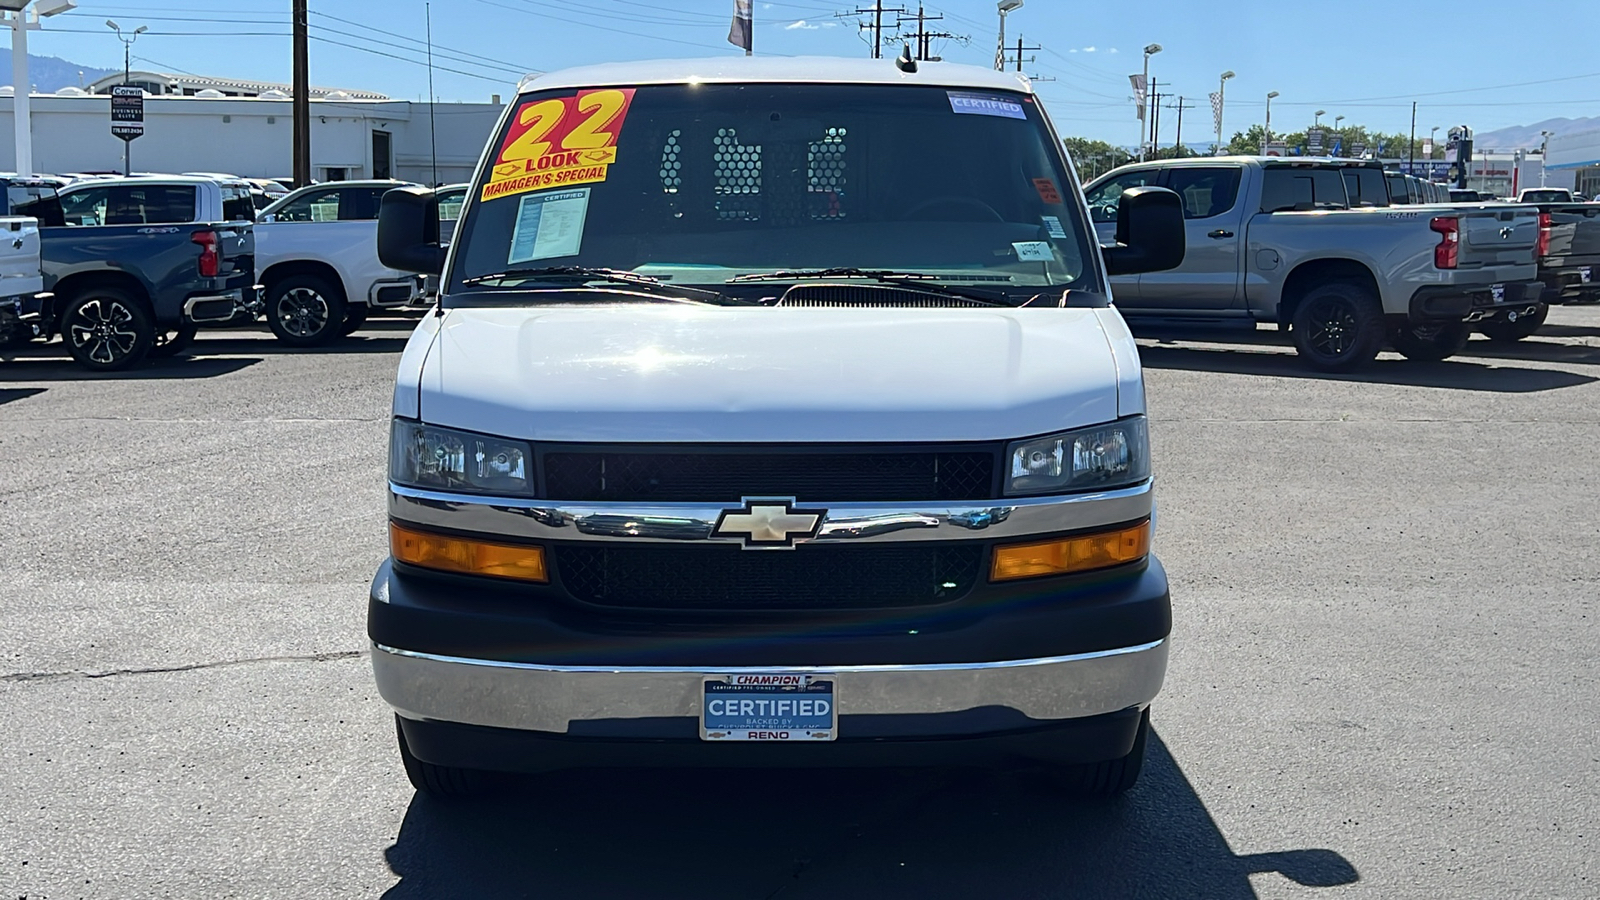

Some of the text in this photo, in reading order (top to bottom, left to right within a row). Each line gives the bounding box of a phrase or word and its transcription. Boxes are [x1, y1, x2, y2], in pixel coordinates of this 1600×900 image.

[953, 98, 1020, 112] CERTIFIED
[501, 89, 627, 162] 22
[525, 151, 582, 173] LOOK
[483, 167, 606, 197] MANAGER'S SPECIAL
[544, 192, 584, 202] CERTIFIED
[737, 676, 801, 684] CHAMPION
[708, 699, 830, 717] CERTIFIED
[748, 731, 790, 740] RENO
